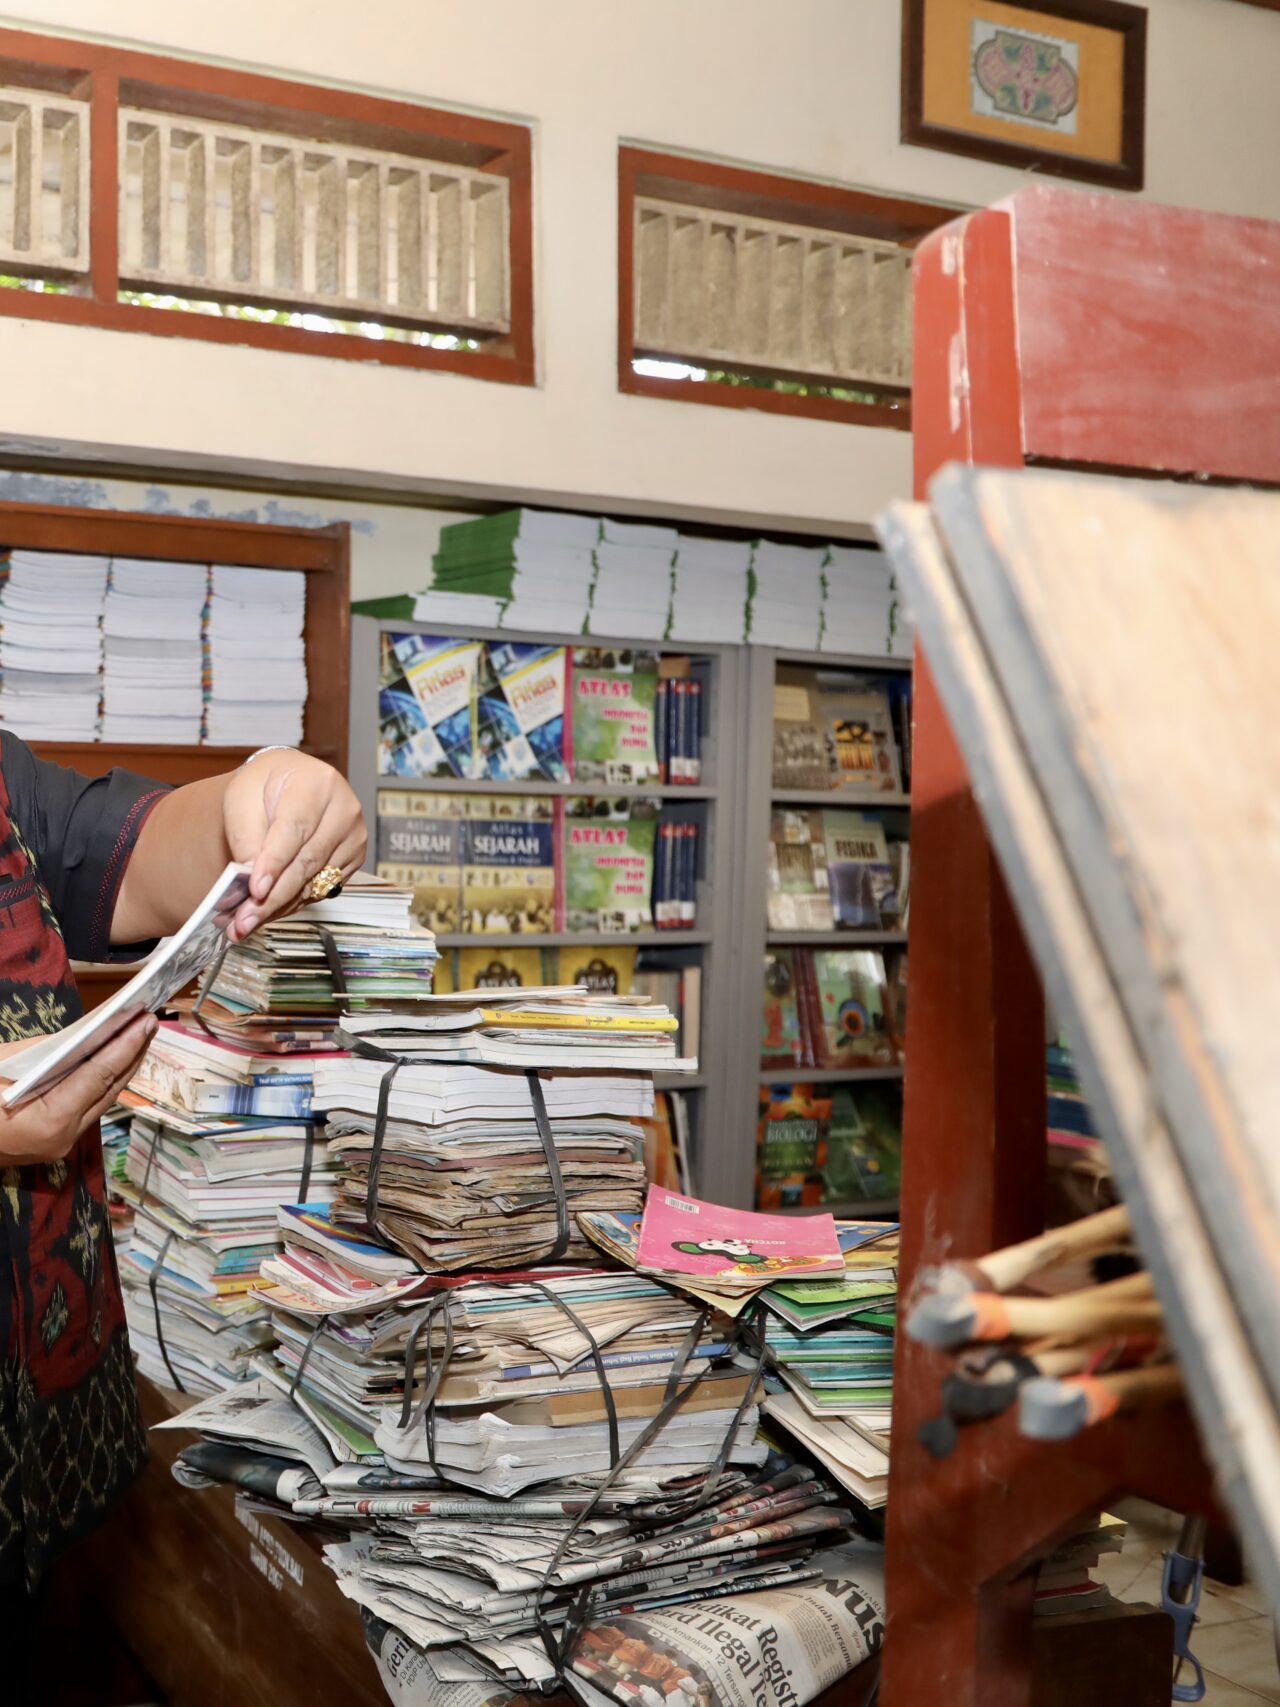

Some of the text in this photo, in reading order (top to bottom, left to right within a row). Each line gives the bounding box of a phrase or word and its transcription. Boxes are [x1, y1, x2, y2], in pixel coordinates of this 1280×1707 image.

[389, 832, 451, 853] SEJARAH
[473, 836, 540, 855] SEJARAH
[834, 840, 879, 859] FISIKA
[804, 1577, 886, 1656] Nus
[805, 1597, 833, 1625] Indah
[858, 1588, 886, 1619] HARIA
[386, 1635, 414, 1679] Gerin
[652, 1608, 701, 1626] ard
[697, 1617, 761, 1680] Ilegal
[749, 1671, 768, 1707] Te
[670, 1627, 714, 1655] Amankan
[715, 1654, 726, 1667] 12
[723, 1665, 748, 1707] Tersang
[683, 1602, 762, 1631] ndikat
[756, 1625, 798, 1707] Regist
[406, 1667, 418, 1688] PDIP
